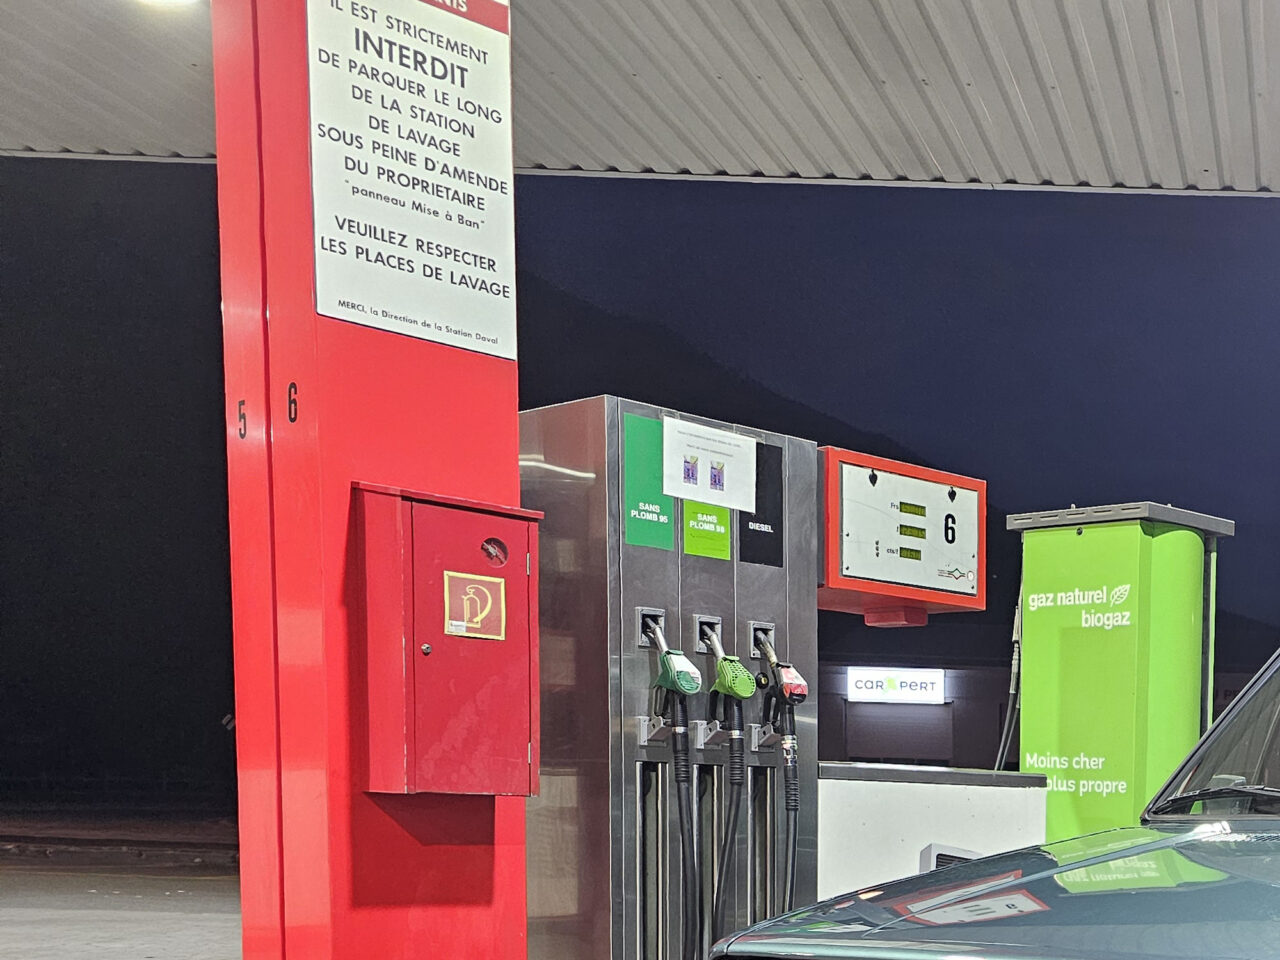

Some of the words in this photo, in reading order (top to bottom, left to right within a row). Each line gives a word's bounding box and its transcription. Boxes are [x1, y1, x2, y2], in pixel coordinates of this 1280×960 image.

[351, 2, 378, 23] EST
[385, 15, 489, 65] STRICTEMENT
[354, 27, 469, 89] INTERDIT
[318, 48, 341, 69] DE
[348, 58, 427, 99] PARQUER
[434, 88, 450, 106] LE
[457, 97, 503, 124] LONG
[351, 84, 373, 104] DE
[381, 94, 402, 115] LA
[409, 105, 476, 139] STATION
[368, 115, 390, 135] DE
[397, 124, 461, 157] LAVAGE
[317, 123, 364, 150] SOUS
[372, 140, 417, 167] PEINE
[424, 157, 509, 196] D'AMENDE
[344, 155, 369, 176] DU
[377, 165, 486, 211] PROPRIETAIRE
[411, 200, 440, 218] Mise
[445, 210, 453, 222] à
[334, 215, 409, 249] VEUILLEZ
[415, 237, 497, 273] RESPECTER
[320, 235, 347, 256] LES
[355, 245, 415, 274] PLACES
[422, 263, 443, 281] DE
[450, 270, 511, 299] LAVAGE
[338, 299, 367, 314] MERCI,
[370, 306, 379, 316] la
[382, 309, 419, 327] Direction
[421, 319, 432, 329] de
[434, 322, 443, 332] la
[445, 324, 473, 339] Station
[237, 399, 248, 440] 5
[287, 381, 299, 423] 6
[630, 509, 658, 522] PLOMB
[638, 501, 661, 513] SANS
[689, 520, 716, 532] PLOMB
[697, 513, 718, 524] SANS
[748, 521, 775, 533] DIESEL
[944, 513, 957, 544] 6
[1028, 592, 1055, 611] gaz
[1056, 585, 1107, 606] naturel
[1081, 609, 1131, 630] biogaz
[1025, 752, 1069, 769] Moins
[1072, 752, 1106, 770] cher
[1079, 780, 1127, 797] propre
